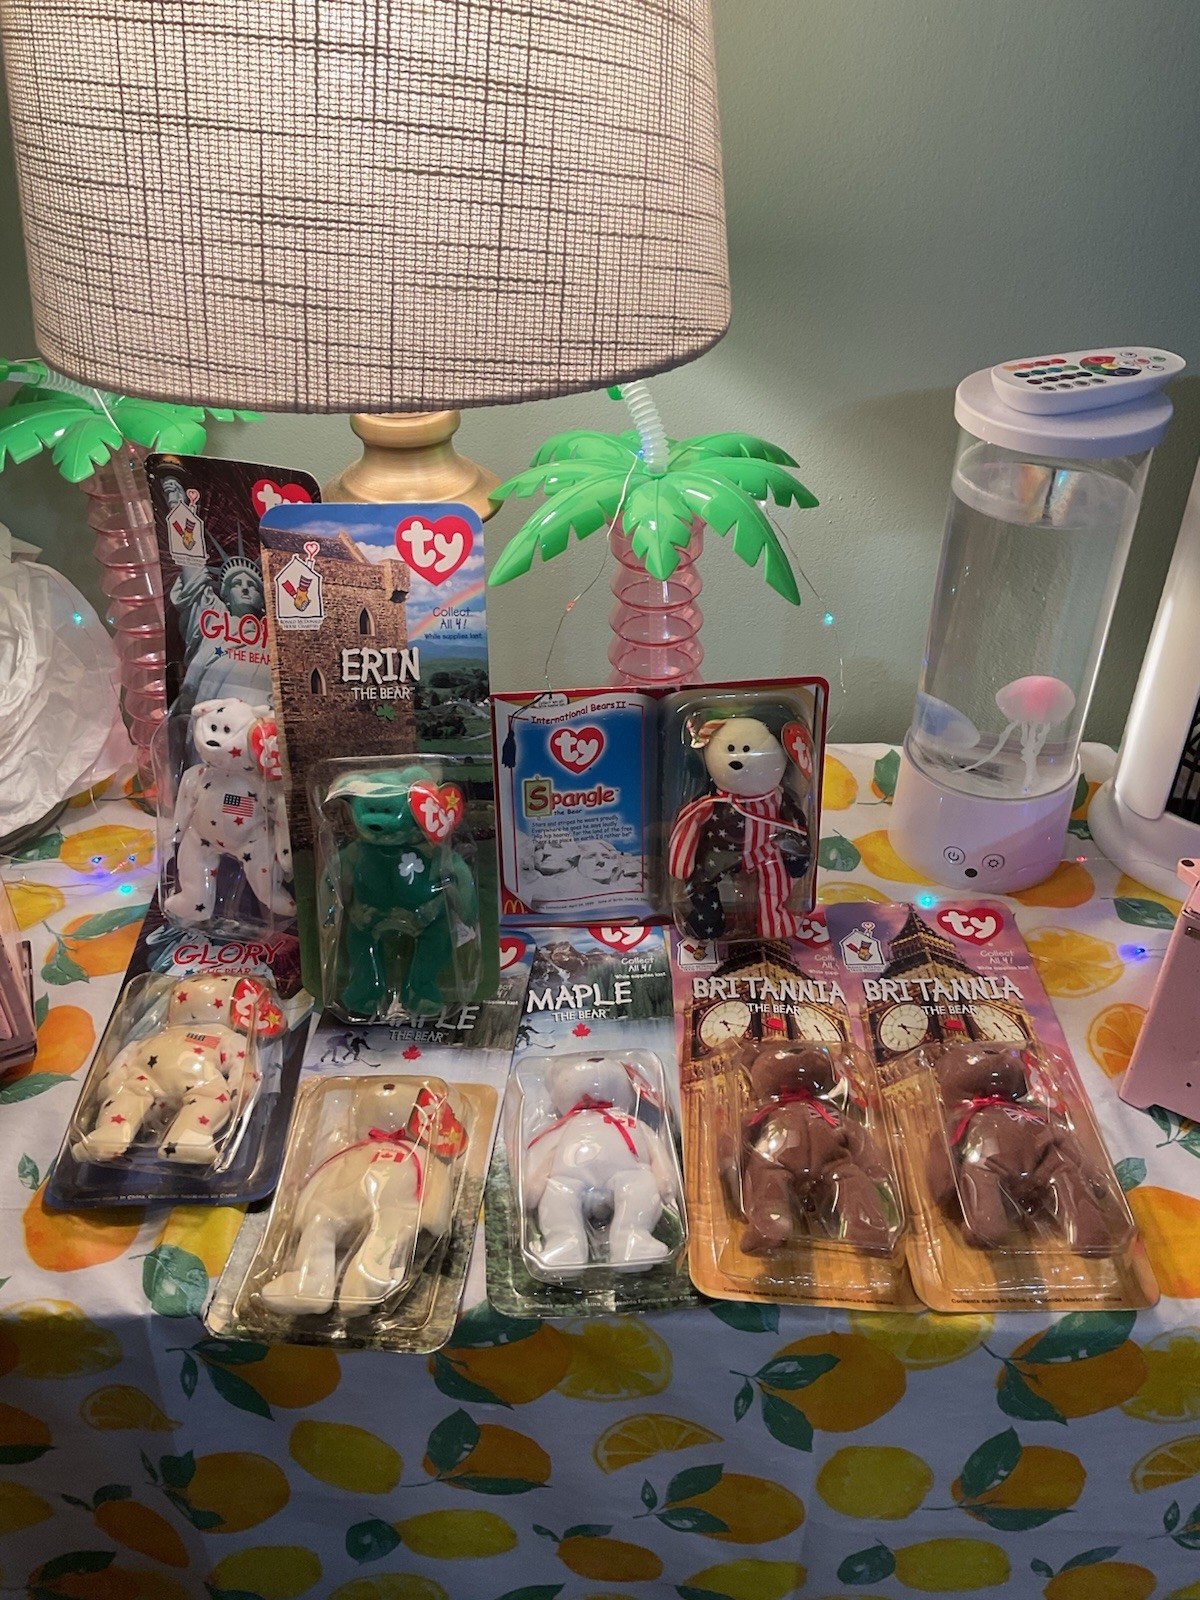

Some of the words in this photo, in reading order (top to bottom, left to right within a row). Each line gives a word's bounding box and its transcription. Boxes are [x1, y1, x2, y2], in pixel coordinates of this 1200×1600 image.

[401, 520, 464, 573] ty
[432, 606, 472, 618] Collect
[440, 618, 453, 630] All
[226, 648, 247, 661] THE
[341, 647, 420, 683] ERIN
[352, 687, 377, 700] THE
[380, 686, 411, 699] BEAR
[531, 705, 588, 725] International
[590, 701, 615, 712] Bears
[616, 701, 627, 709] II
[554, 731, 599, 766] ty
[528, 785, 615, 811] Spangle
[419, 797, 455, 837] ty
[941, 910, 999, 937] ty
[173, 940, 285, 966] GLORY
[621, 956, 655, 966] Collect
[980, 950, 1014, 958] Collect
[628, 964, 640, 973] All
[526, 981, 633, 1013] MAPLE
[692, 976, 847, 1003] BRITANNIA
[863, 976, 1025, 1001] BRITANNIA
[552, 1011, 576, 1022] THE
[578, 1008, 607, 1019] BEAR
[749, 1003, 769, 1013] THE
[772, 1004, 800, 1015] BEAR
[922, 1005, 944, 1014] THE
[948, 1005, 977, 1015] BEAR
[390, 1029, 412, 1040] THE
[415, 1030, 444, 1043] BEAR
